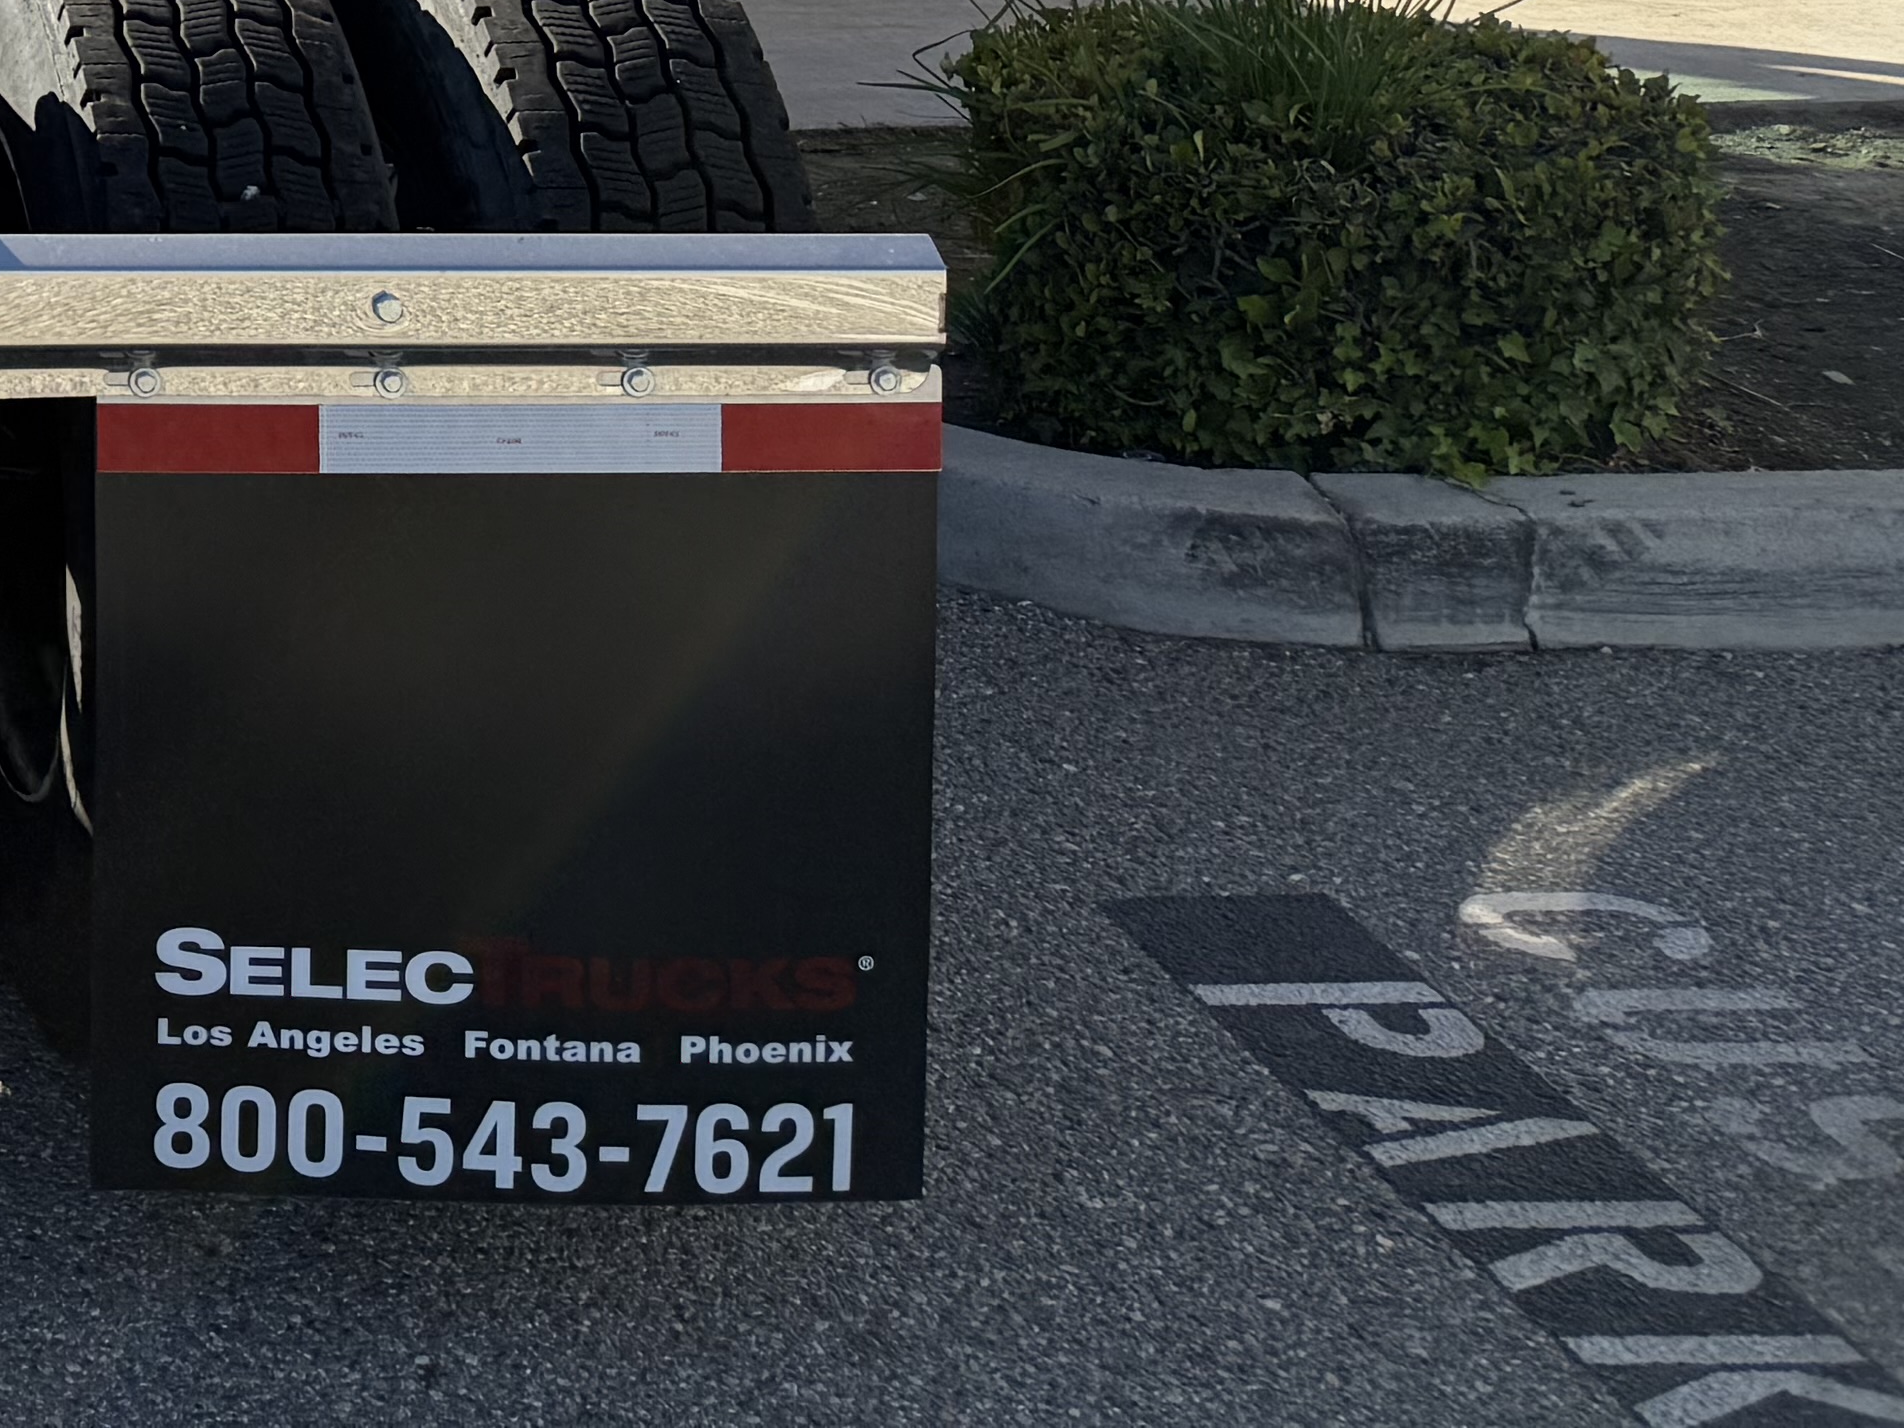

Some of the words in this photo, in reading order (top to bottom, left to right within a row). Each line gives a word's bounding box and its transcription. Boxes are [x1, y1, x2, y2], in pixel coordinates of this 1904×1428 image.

[157, 1017, 233, 1047] Los
[247, 1021, 425, 1058] Angeles
[464, 1030, 641, 1064] Fontana
[680, 1034, 854, 1064] Phoenix
[153, 1082, 854, 1194] 800-543-7621
